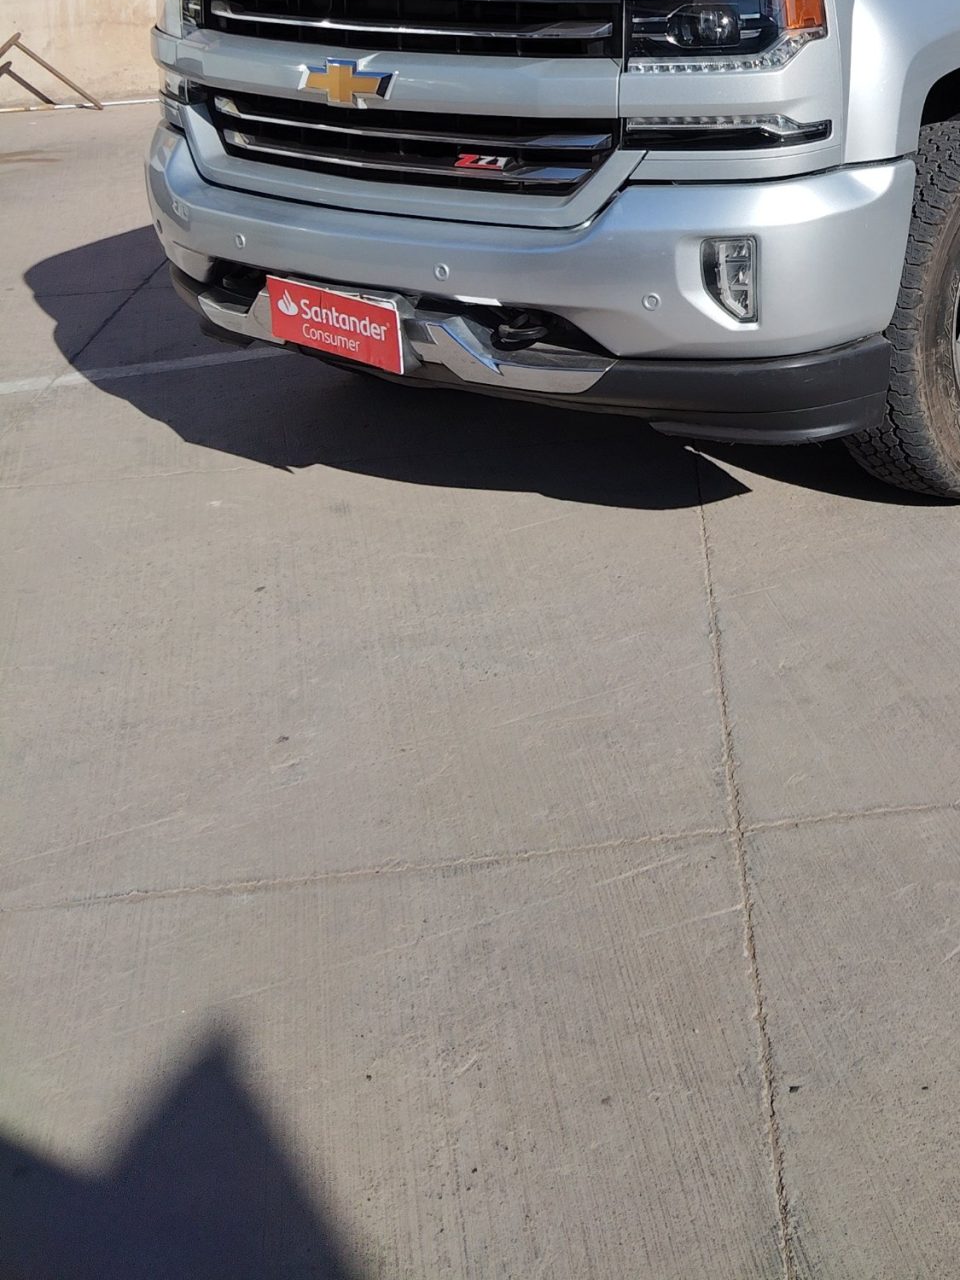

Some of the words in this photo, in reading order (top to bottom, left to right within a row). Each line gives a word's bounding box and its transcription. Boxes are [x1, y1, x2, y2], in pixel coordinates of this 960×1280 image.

[454, 153, 509, 170] Z71
[300, 298, 388, 341] Santander
[302, 323, 360, 352] Consumer
